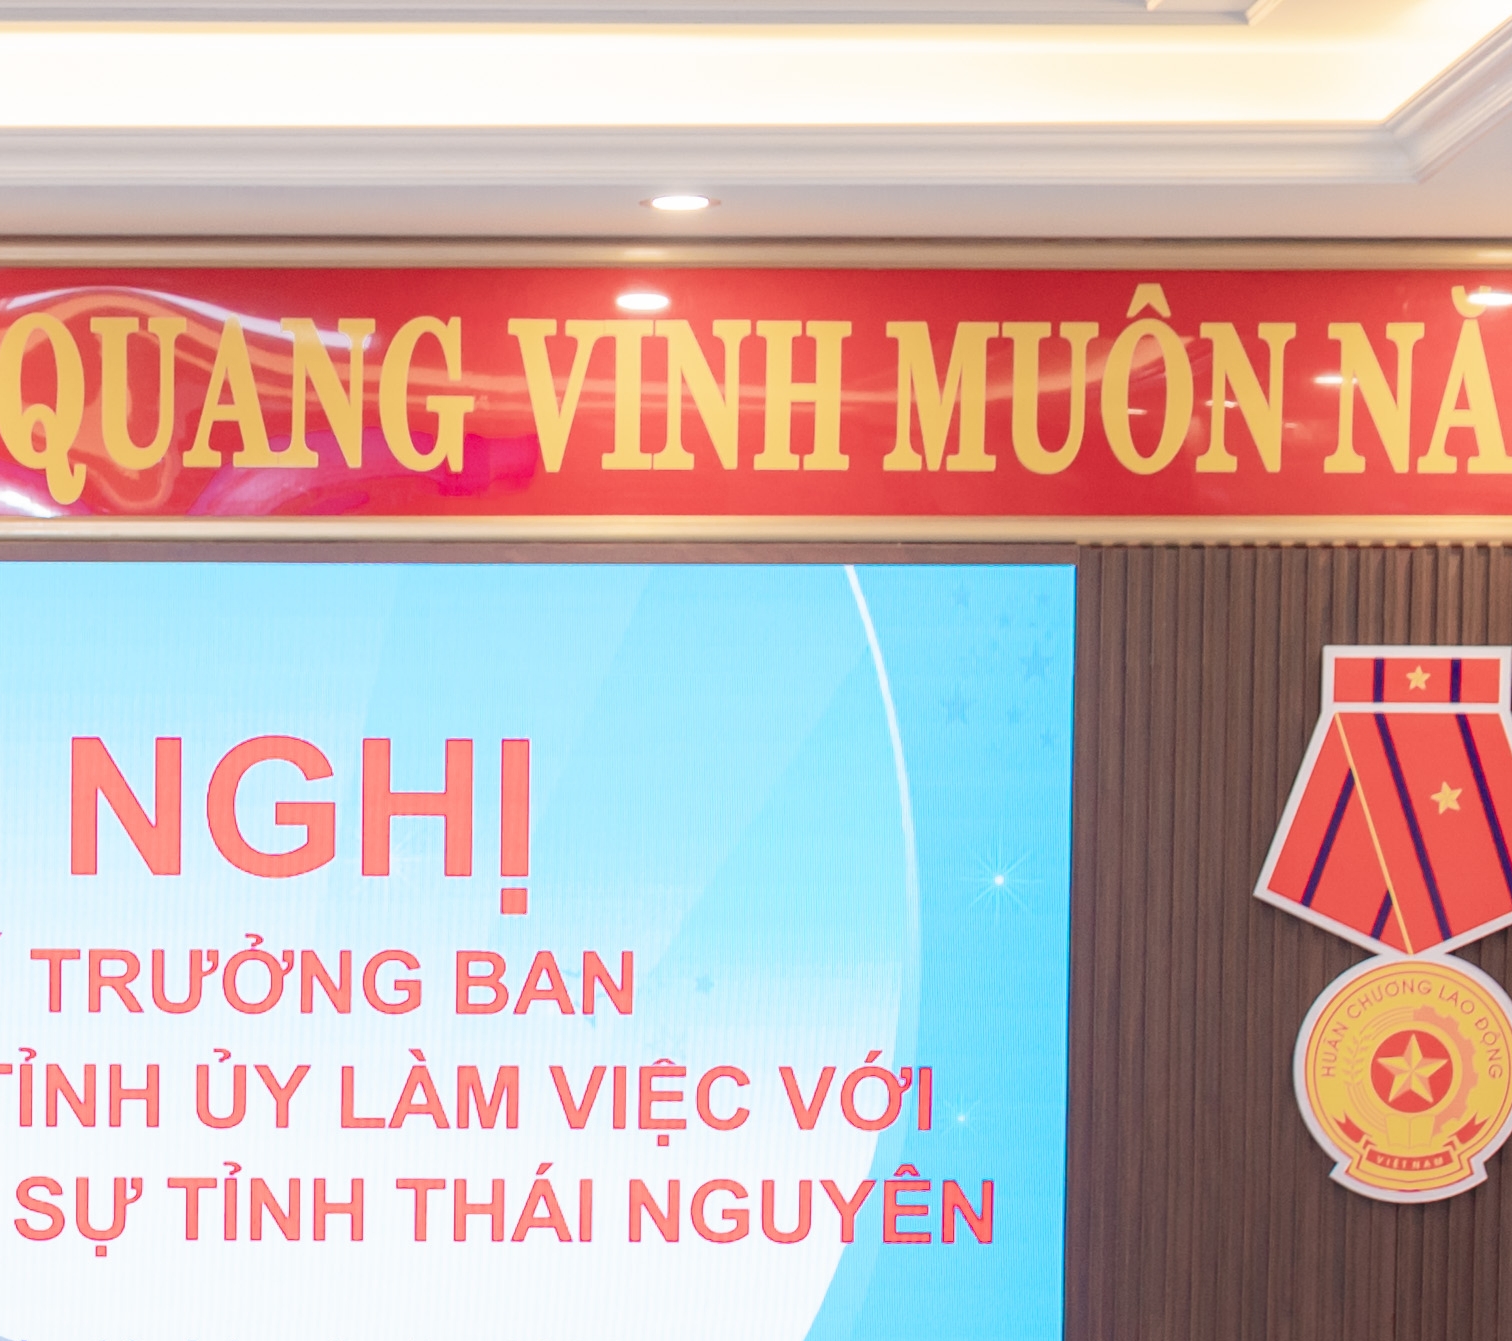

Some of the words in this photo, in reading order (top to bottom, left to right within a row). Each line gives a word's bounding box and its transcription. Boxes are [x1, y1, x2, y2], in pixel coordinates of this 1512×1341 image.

[884, 284, 1296, 476] MUÔN
[71, 734, 531, 915] NGHỊ
[30, 932, 422, 1015] TRƯỞNG
[455, 950, 634, 1016] BAN
[1438, 984, 1476, 1016] LAO
[195, 1047, 311, 1130] ỦY
[340, 1048, 520, 1130] LÀM
[549, 1058, 751, 1147] VIỆC
[778, 1049, 933, 1132] VỚI
[13, 1175, 144, 1258] SỰ
[166, 1161, 365, 1242] TỈNH
[395, 1162, 593, 1243] THÁI
[628, 1163, 995, 1246] NGUYÊN
